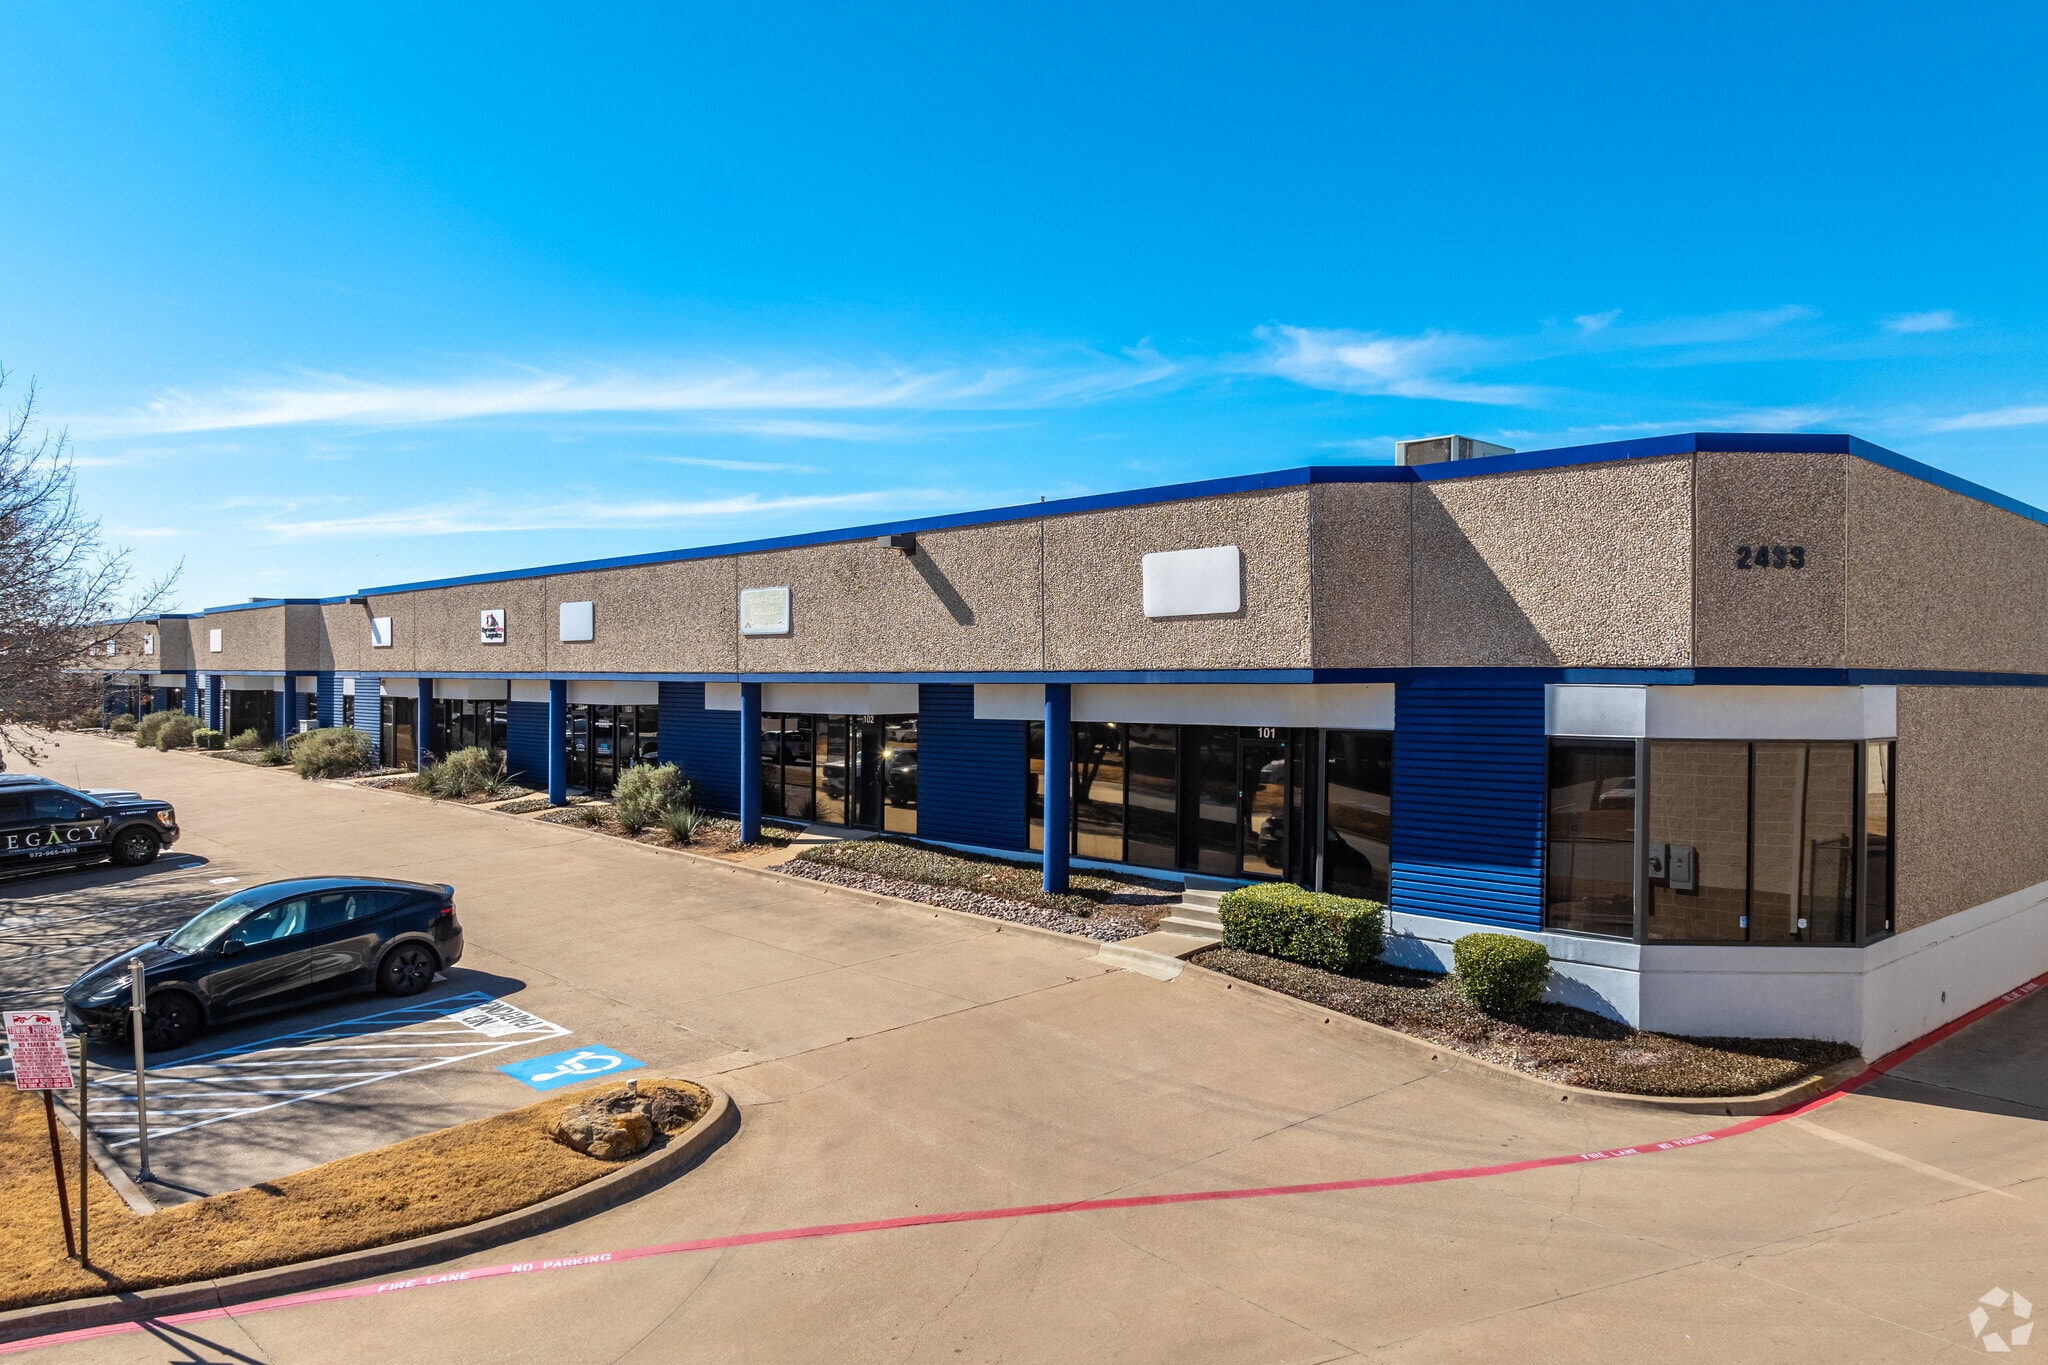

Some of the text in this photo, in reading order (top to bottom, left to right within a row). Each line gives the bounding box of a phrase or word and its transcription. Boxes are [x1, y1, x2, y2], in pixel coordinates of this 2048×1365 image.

[1737, 546, 1805, 570] 2433
[863, 715, 875, 724] 102
[1258, 727, 1276, 739] 101
[29, 847, 78, 858] 972-965-4915
[7, 1025, 61, 1034] TOWING ENFORCED
[1656, 1134, 1715, 1150] NO PARKING
[1579, 1148, 1641, 1160] FIRE LANE
[511, 1253, 612, 1273] NO PARKING
[377, 1271, 471, 1293] FIRE LANE
